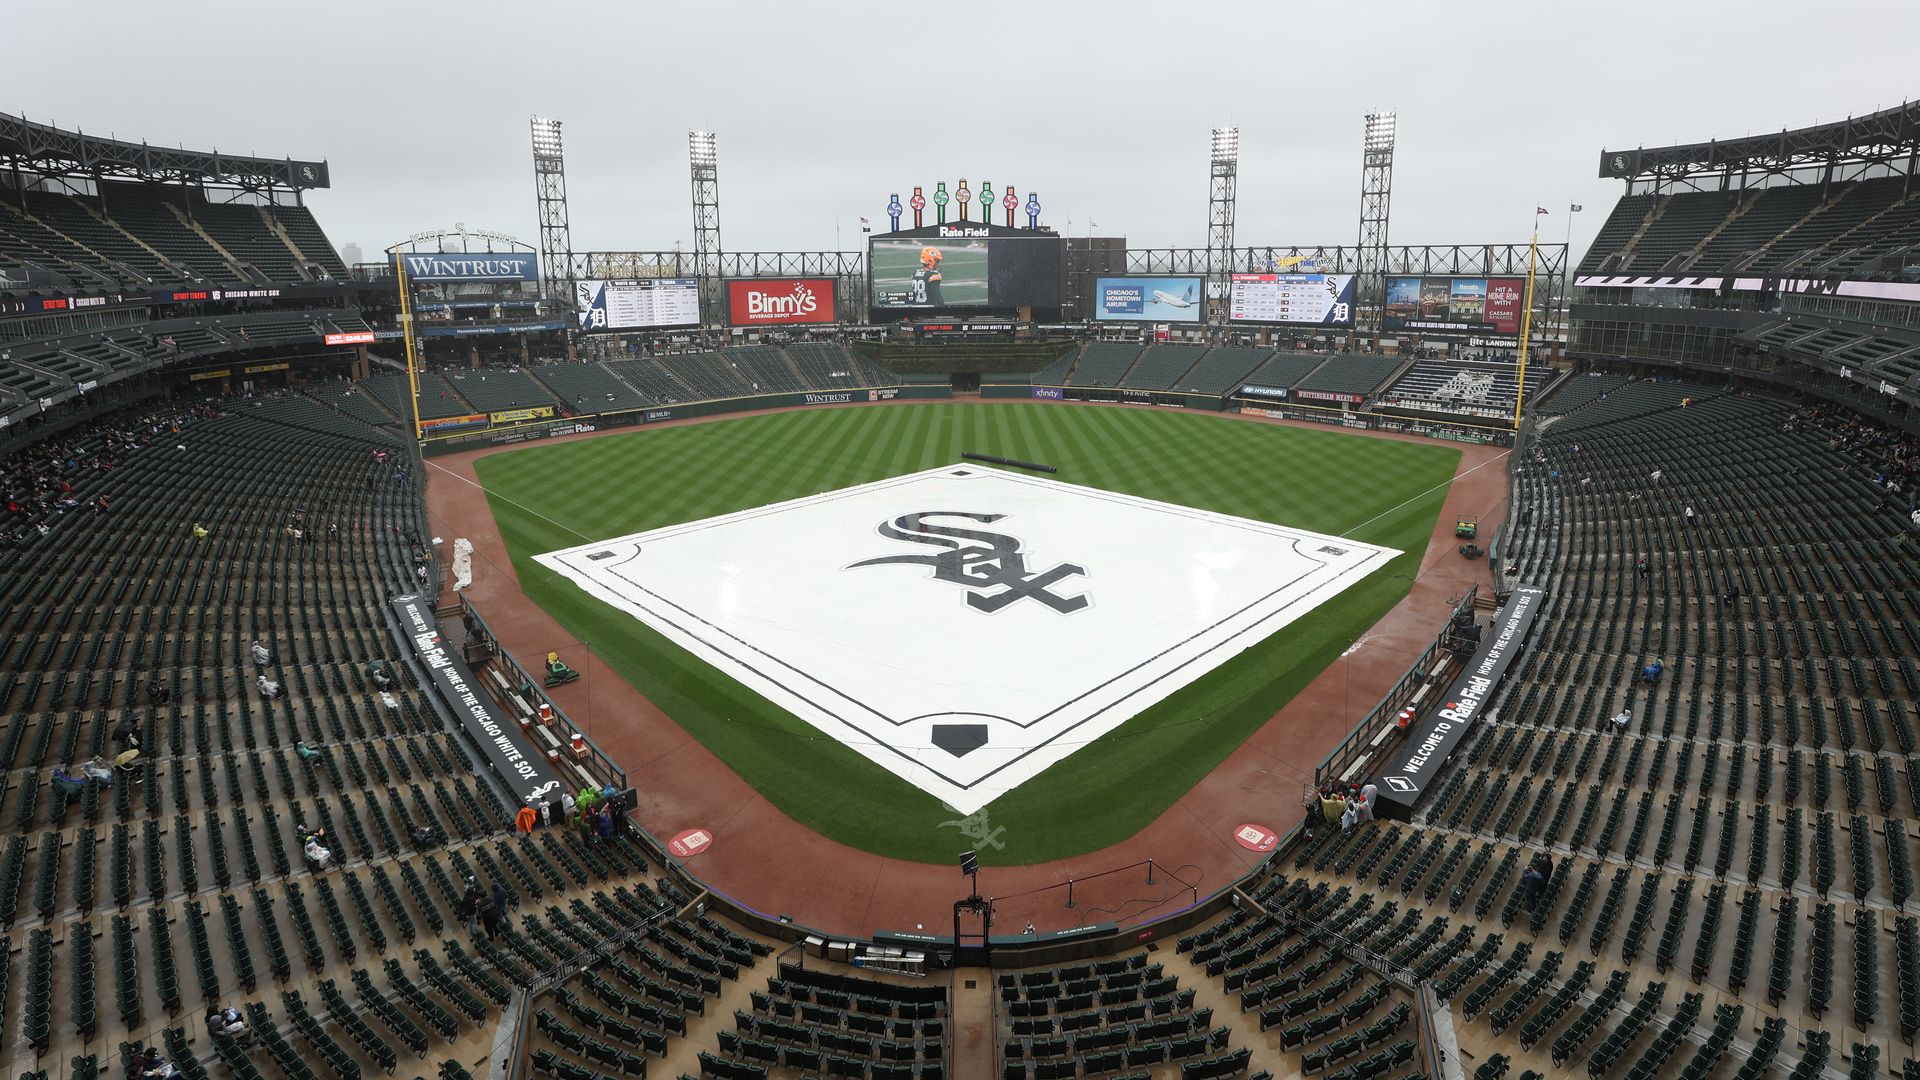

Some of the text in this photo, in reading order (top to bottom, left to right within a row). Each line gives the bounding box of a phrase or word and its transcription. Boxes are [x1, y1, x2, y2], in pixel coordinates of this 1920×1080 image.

[409, 229, 448, 245] KIDS
[476, 229, 517, 246] ZONE
[940, 226, 988, 237] Rate Field
[408, 257, 525, 276] WINTRUST
[212, 291, 220, 300] VS
[805, 394, 851, 402] WINTRUST
[1036, 390, 1058, 398] xfinity
[1298, 391, 1353, 402] WHITTINGHAM MEATS
[576, 423, 595, 433] Rate
[405, 604, 424, 626] WELCOME
[414, 631, 438, 651] Rate
[423, 648, 452, 668] Field
[442, 666, 463, 685] HOME
[454, 683, 468, 692] OF
[1403, 596, 1531, 773] WELCOME TO Rate Field HOME OF THE CHICAGO WHITE SOX
[461, 692, 481, 706] THE
[470, 702, 501, 736] CHICAGO
[494, 734, 523, 762] WHITE
[514, 761, 538, 780] SOX
[672, 841, 687, 855] TOYOTA
